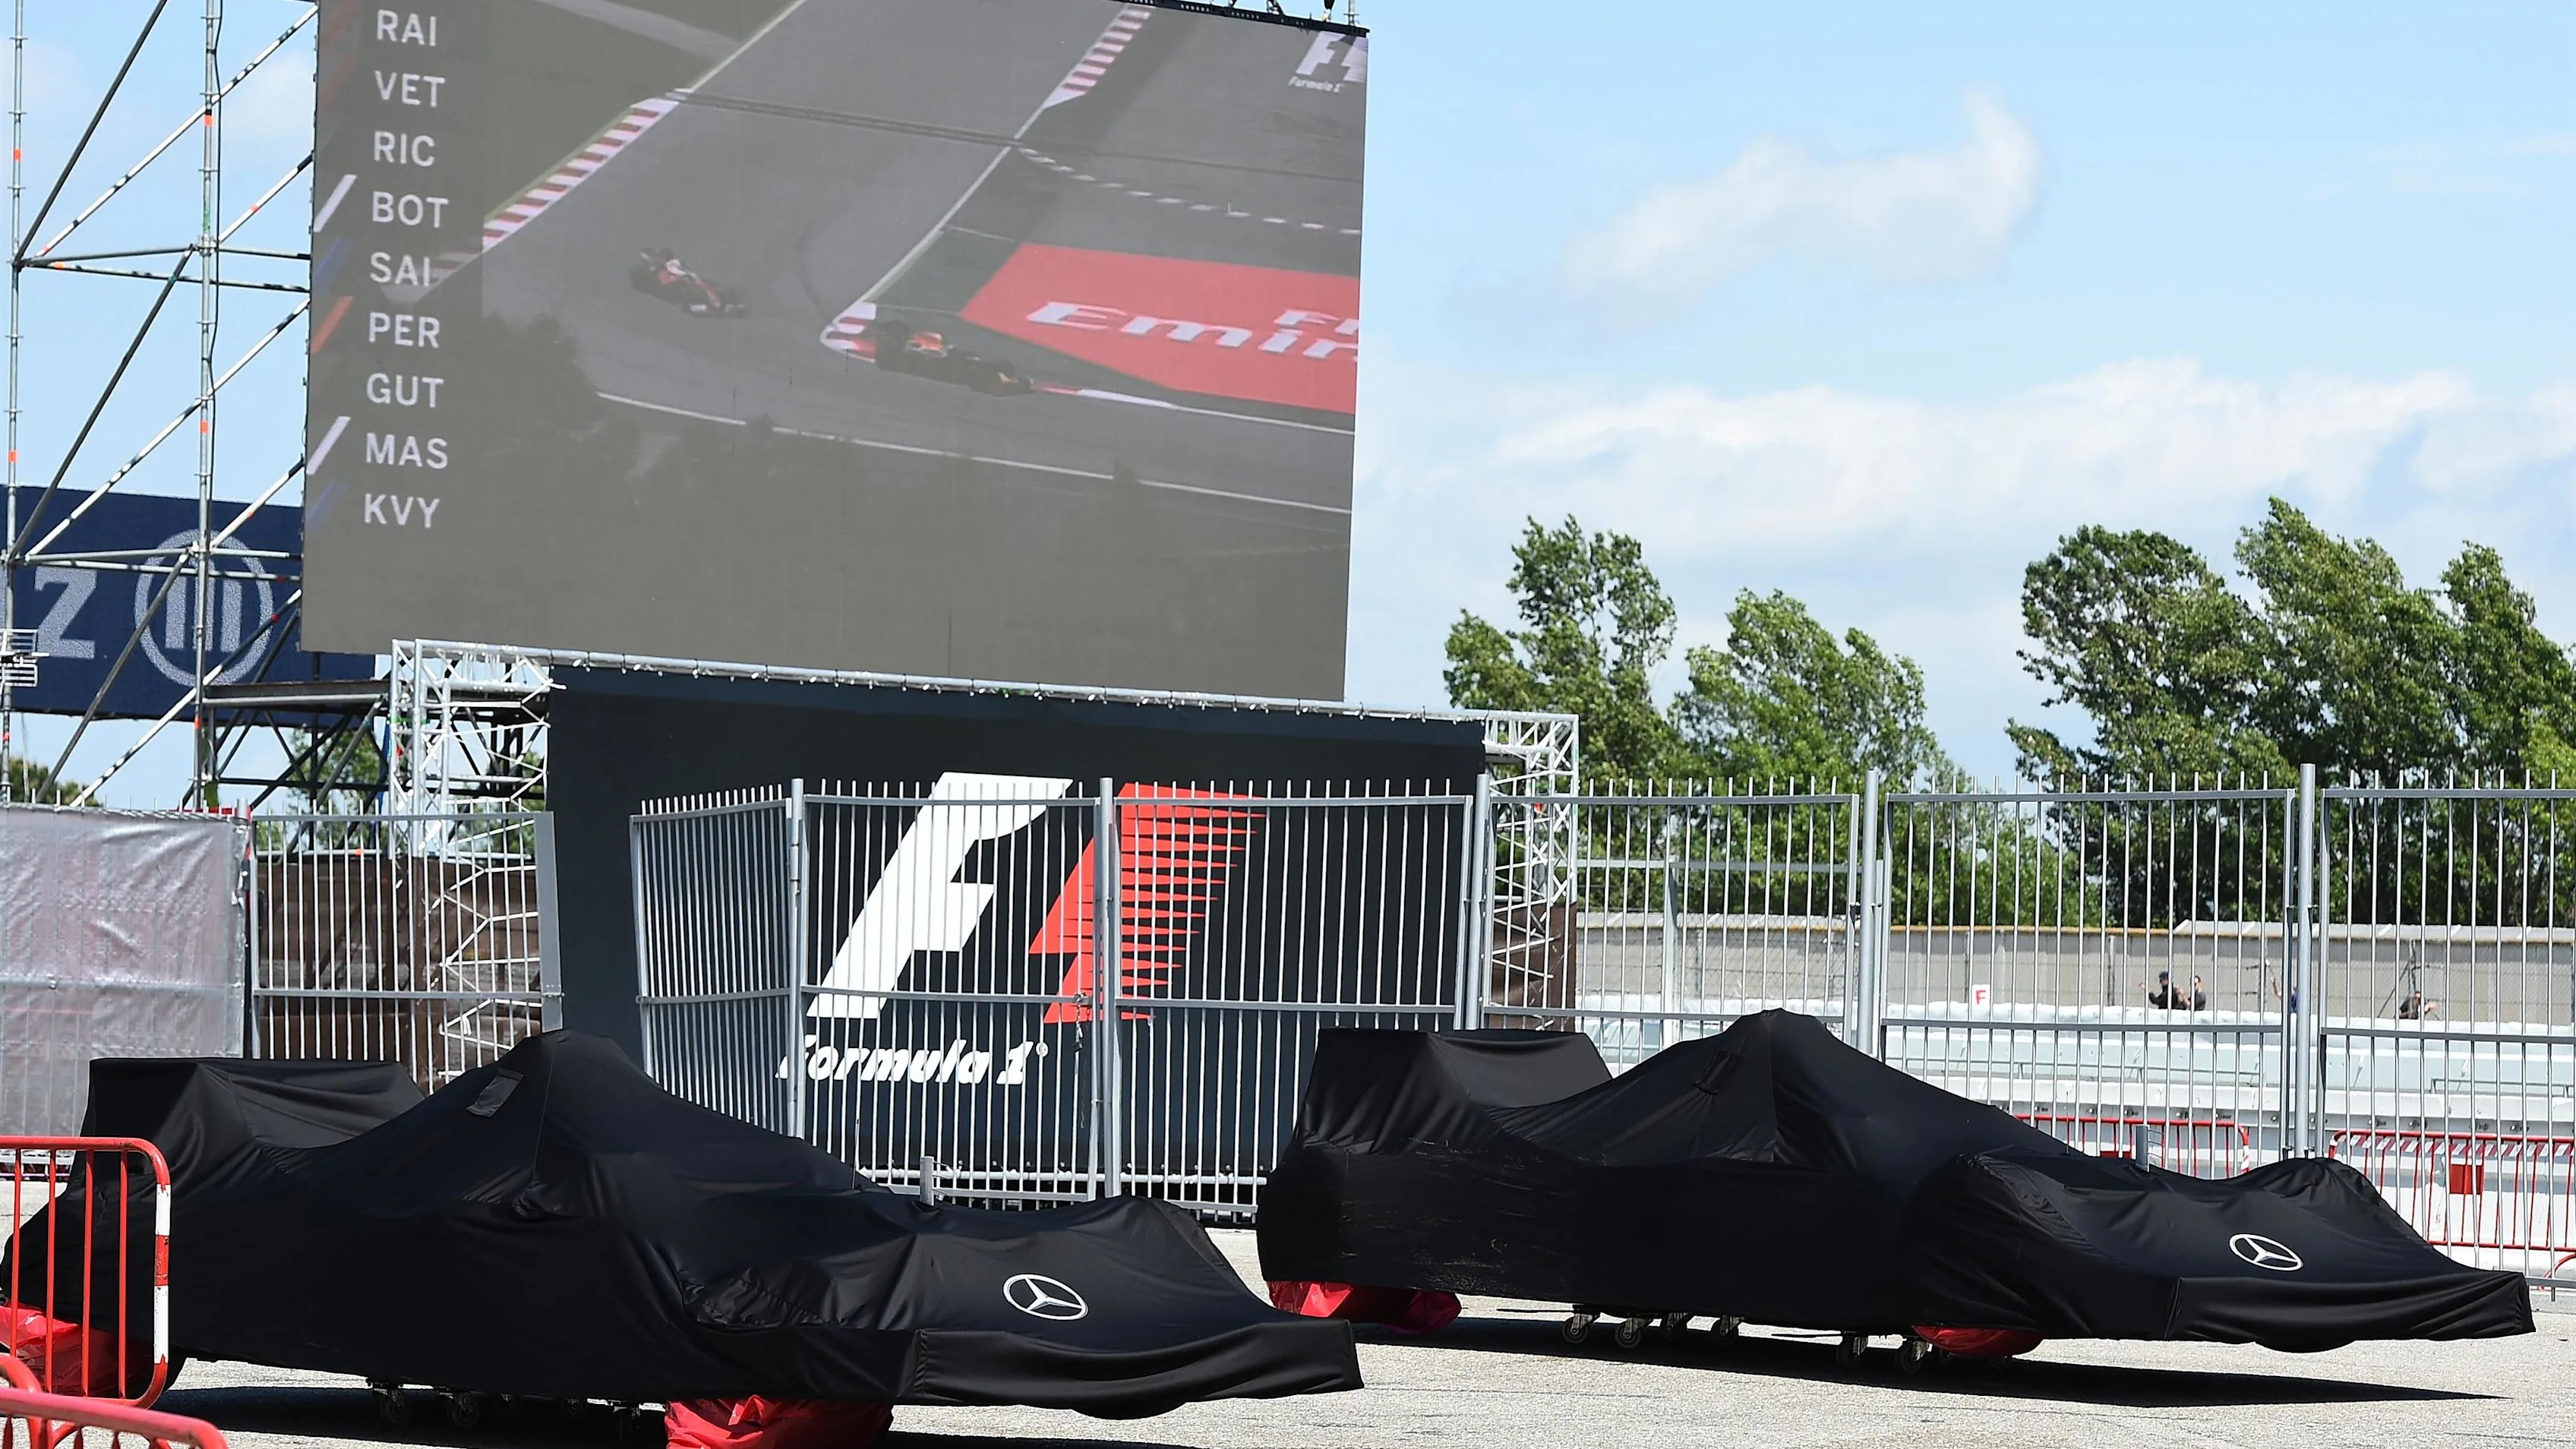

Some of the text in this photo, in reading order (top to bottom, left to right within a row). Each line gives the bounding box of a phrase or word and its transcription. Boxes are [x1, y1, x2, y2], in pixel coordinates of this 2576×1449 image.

[377, 9, 437, 46] RAI
[374, 70, 446, 107] VET
[373, 130, 435, 166] RIC
[372, 191, 449, 228] BOT
[370, 251, 431, 287] SAI
[368, 311, 440, 349] PER
[366, 372, 444, 408] GUT
[365, 432, 448, 469] MAS
[364, 493, 440, 529] KVY
[1975, 990, 1986, 1005] F
